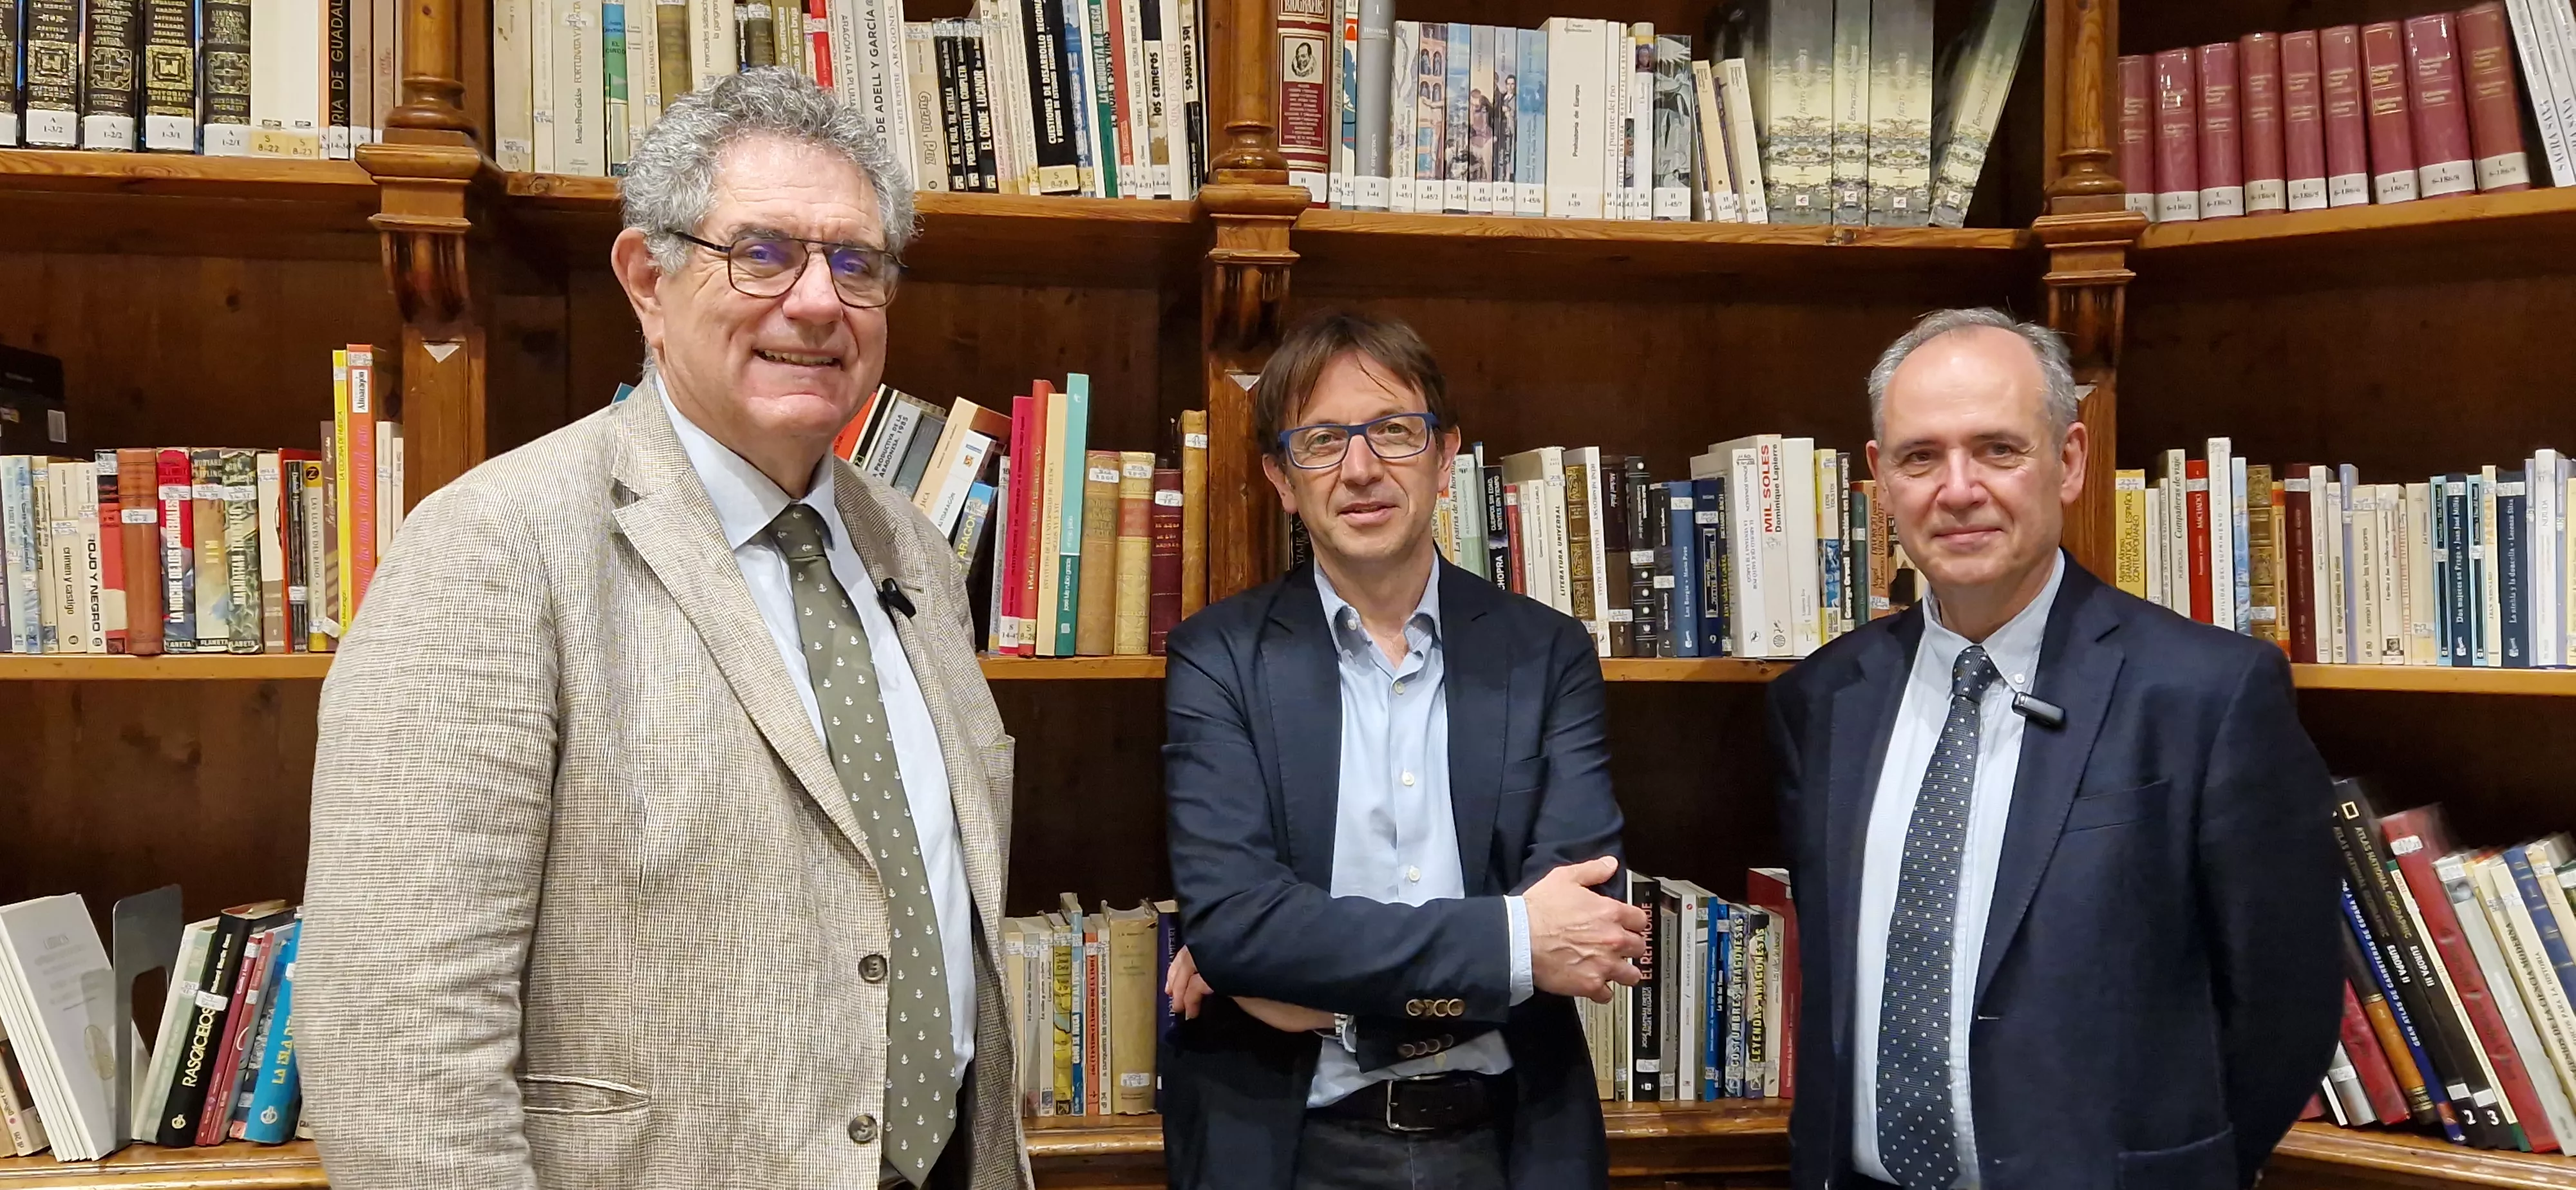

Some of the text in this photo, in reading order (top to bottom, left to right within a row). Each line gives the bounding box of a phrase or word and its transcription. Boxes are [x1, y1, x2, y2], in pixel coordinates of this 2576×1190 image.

[841, 14, 853, 53] ARAGÓN
[864, 9, 879, 57] GARCÍA
[846, 64, 853, 75] LA
[1095, 48, 1108, 91] CONQUISTA
[1182, 25, 1194, 91] los cameros
[331, 71, 344, 90] DE
[871, 73, 884, 113] ADELL
[1037, 35, 1057, 144] CUESTIONES DE DESARROLLO
[1150, 52, 1162, 116] los cameros
[945, 87, 956, 112] ASTILLA
[973, 69, 992, 151] EL CONDE LUCANOR
[876, 117, 886, 133] DE
[961, 101, 974, 141] CASTELLANA
[923, 141, 938, 165] Paz
[897, 416, 909, 434] 1985
[875, 432, 895, 471] PRODUCTIVA
[893, 422, 898, 432] DE
[1761, 445, 1773, 533] MIL SOLES
[2172, 456, 2184, 539] Compañeras de viaje
[1452, 504, 1459, 514] de
[1773, 483, 1782, 533] Dominique
[1452, 516, 1462, 540] patria
[2453, 516, 2461, 529] José
[167, 549, 182, 566] LOS
[1454, 542, 1461, 552] La
[63, 547, 72, 576] crimen
[168, 566, 182, 579] DE
[2454, 551, 2463, 571] Praga
[64, 584, 75, 615] castigo
[89, 572, 100, 632] Y NEGRO
[169, 580, 184, 610] NOCHE
[1844, 587, 1853, 618] George
[2456, 581, 2465, 607] mujeres
[170, 612, 184, 623] LA
[2456, 609, 2464, 623] Dos
[2509, 614, 2517, 623] La
[2354, 826, 2412, 939] ATLAS NATIONAL GEOGRAPHIC
[2350, 900, 2367, 927] ESPAÑA
[2363, 929, 2372, 940] DE
[2505, 923, 2530, 968] MODERNA
[1640, 968, 1653, 980] EL
[2369, 941, 2394, 988] CARRETERAS
[2386, 944, 2407, 977] EUROPA
[2410, 945, 2435, 987] EUROPA III
[1731, 918, 1743, 1067] COSTUMBRES ARAGONESAS
[1751, 928, 1765, 1062] LEYENDAS ARAGONESAS
[2392, 990, 2401, 1001] DE
[2397, 1001, 2412, 1025] ATLAS
[2407, 1026, 2421, 1047] GRAN
[272, 1069, 287, 1084] LA
[2463, 1111, 2476, 1125] 2
[2487, 1111, 2500, 1125] 3
